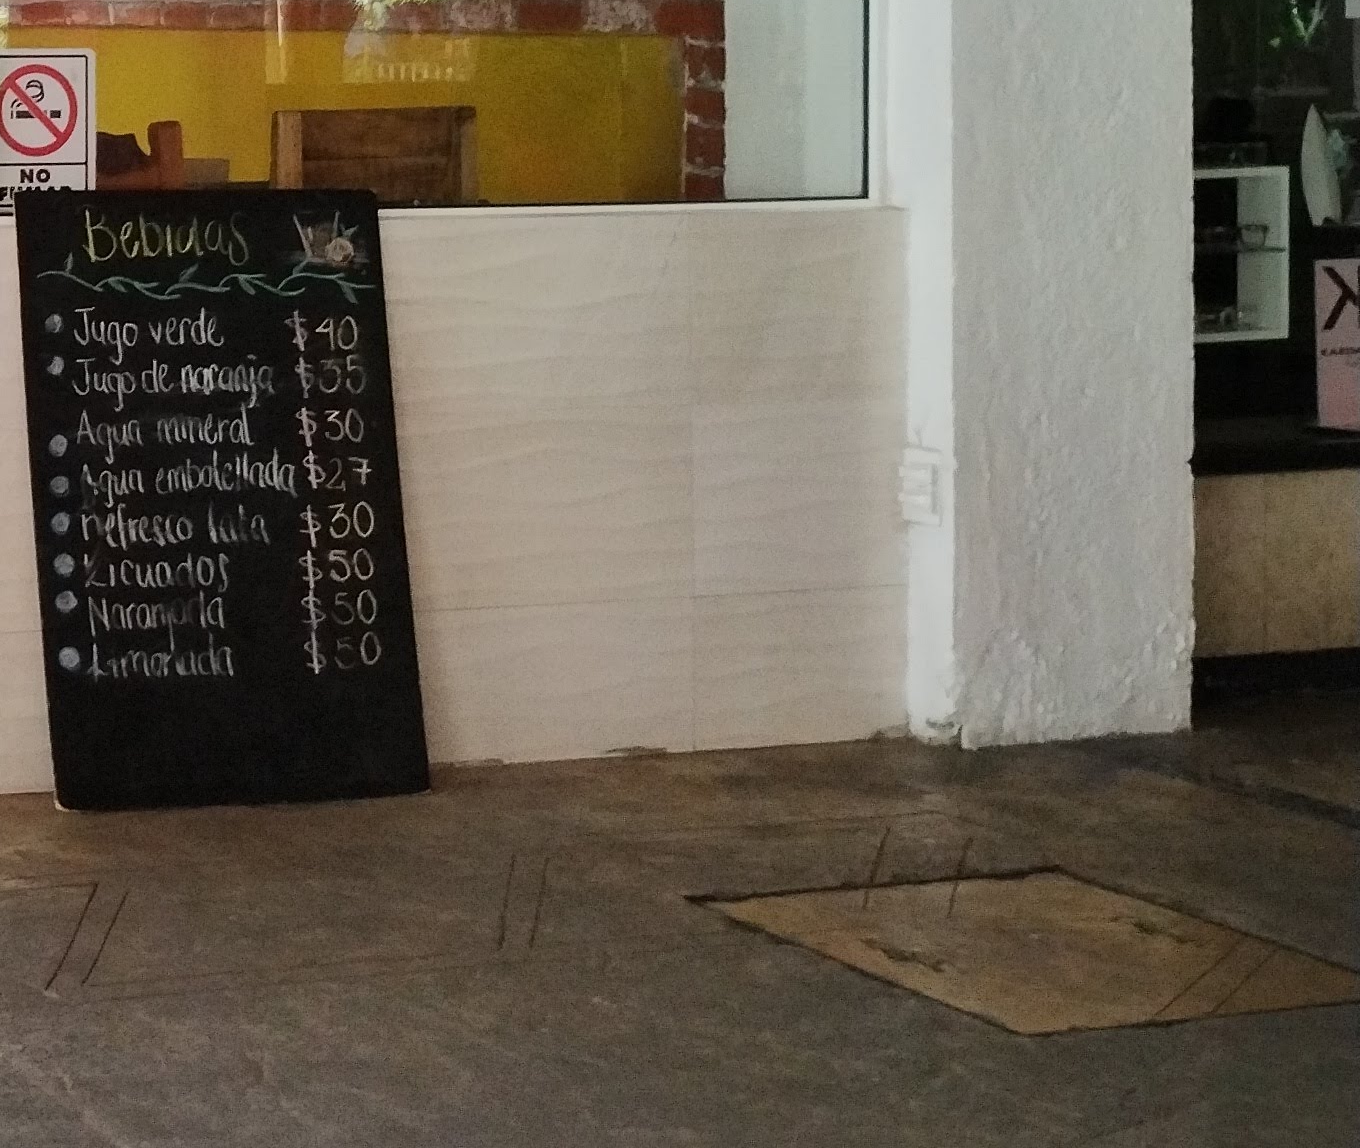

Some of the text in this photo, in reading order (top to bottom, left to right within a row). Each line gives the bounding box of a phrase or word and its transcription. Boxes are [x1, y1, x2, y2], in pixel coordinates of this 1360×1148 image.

[20, 168, 51, 184] NO
[82, 208, 250, 266] Bebidas
[73, 306, 225, 365] Jugo verde
[284, 309, 360, 352] $40
[71, 354, 276, 412] Jugo de naranja
[155, 402, 256, 447] mineral
[295, 406, 365, 448] $30
[302, 450, 373, 492] $27
[298, 500, 375, 548] $30
[297, 548, 375, 591] $50
[300, 588, 378, 631] $50
